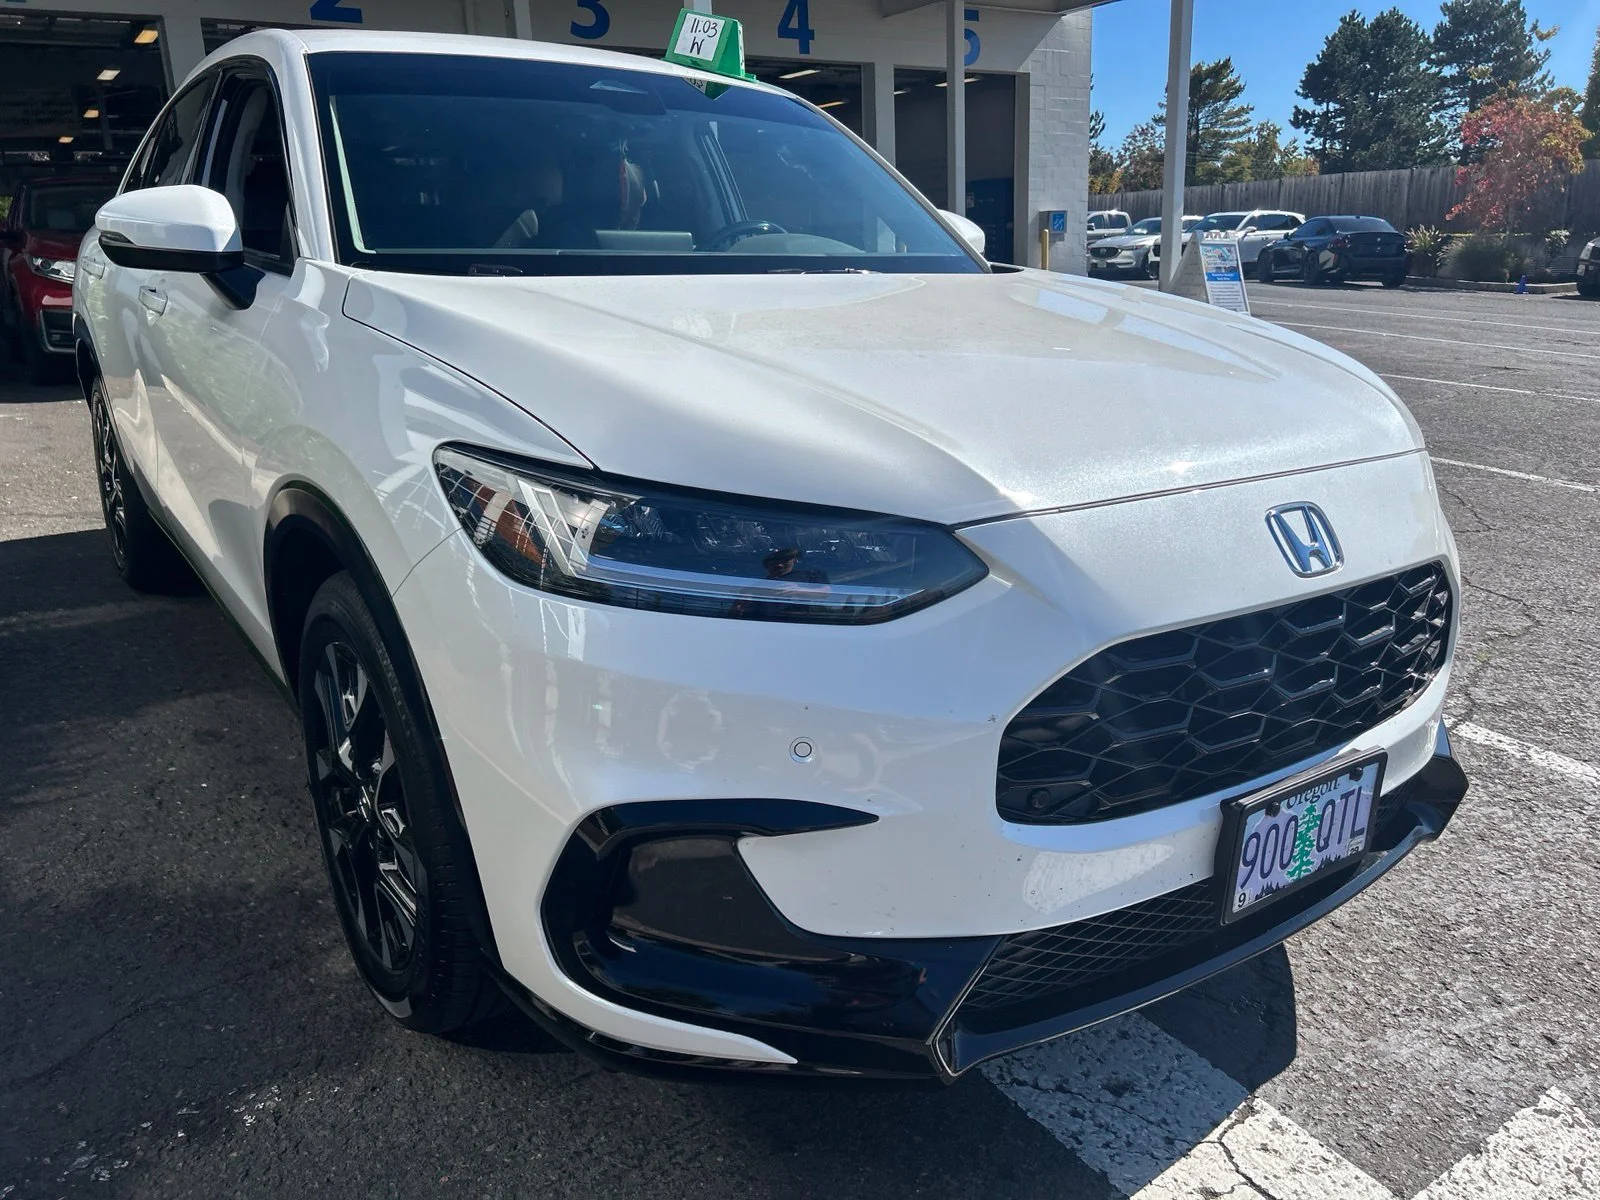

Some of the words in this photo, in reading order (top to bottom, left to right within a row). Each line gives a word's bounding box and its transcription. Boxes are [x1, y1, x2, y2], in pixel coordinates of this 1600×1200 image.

[778, 0, 815, 54] 4
[1286, 779, 1338, 809] Oregon
[1240, 815, 1299, 889] 900
[1315, 786, 1365, 853] QTL
[1237, 892, 1247, 908] 9
